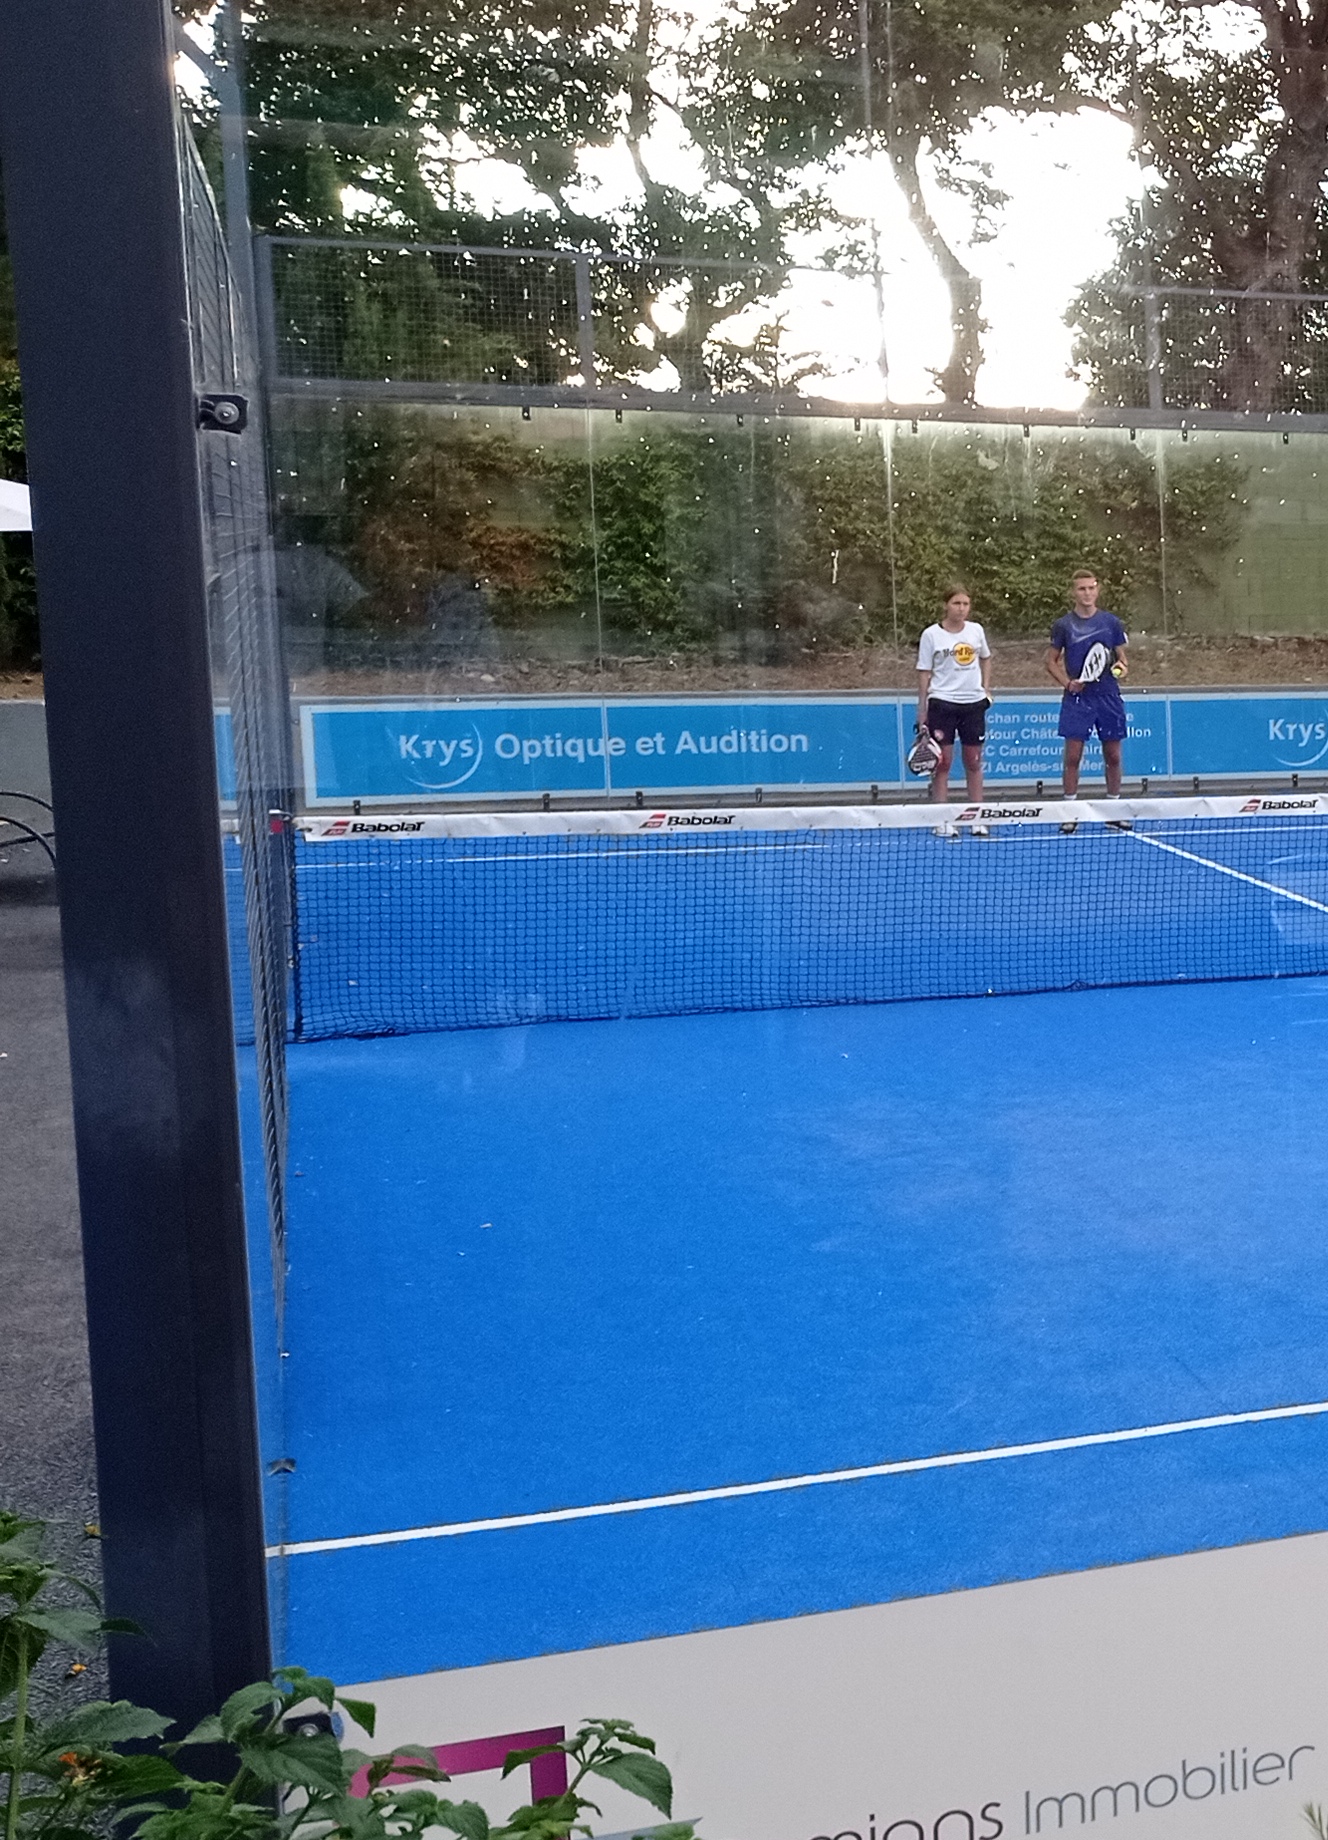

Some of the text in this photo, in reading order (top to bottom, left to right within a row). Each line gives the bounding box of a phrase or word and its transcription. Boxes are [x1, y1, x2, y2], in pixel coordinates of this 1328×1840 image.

[1024, 713, 1060, 724] route
[1268, 719, 1326, 746] Krys
[400, 729, 809, 766] Krys Optique et Audition
[999, 745, 1063, 757] Carrefour
[1262, 799, 1318, 811] Babolat
[980, 808, 1043, 819] Babolat
[667, 814, 736, 827] Babolat
[351, 821, 425, 834] Babolat
[1025, 1745, 1316, 1835] Immobilier
